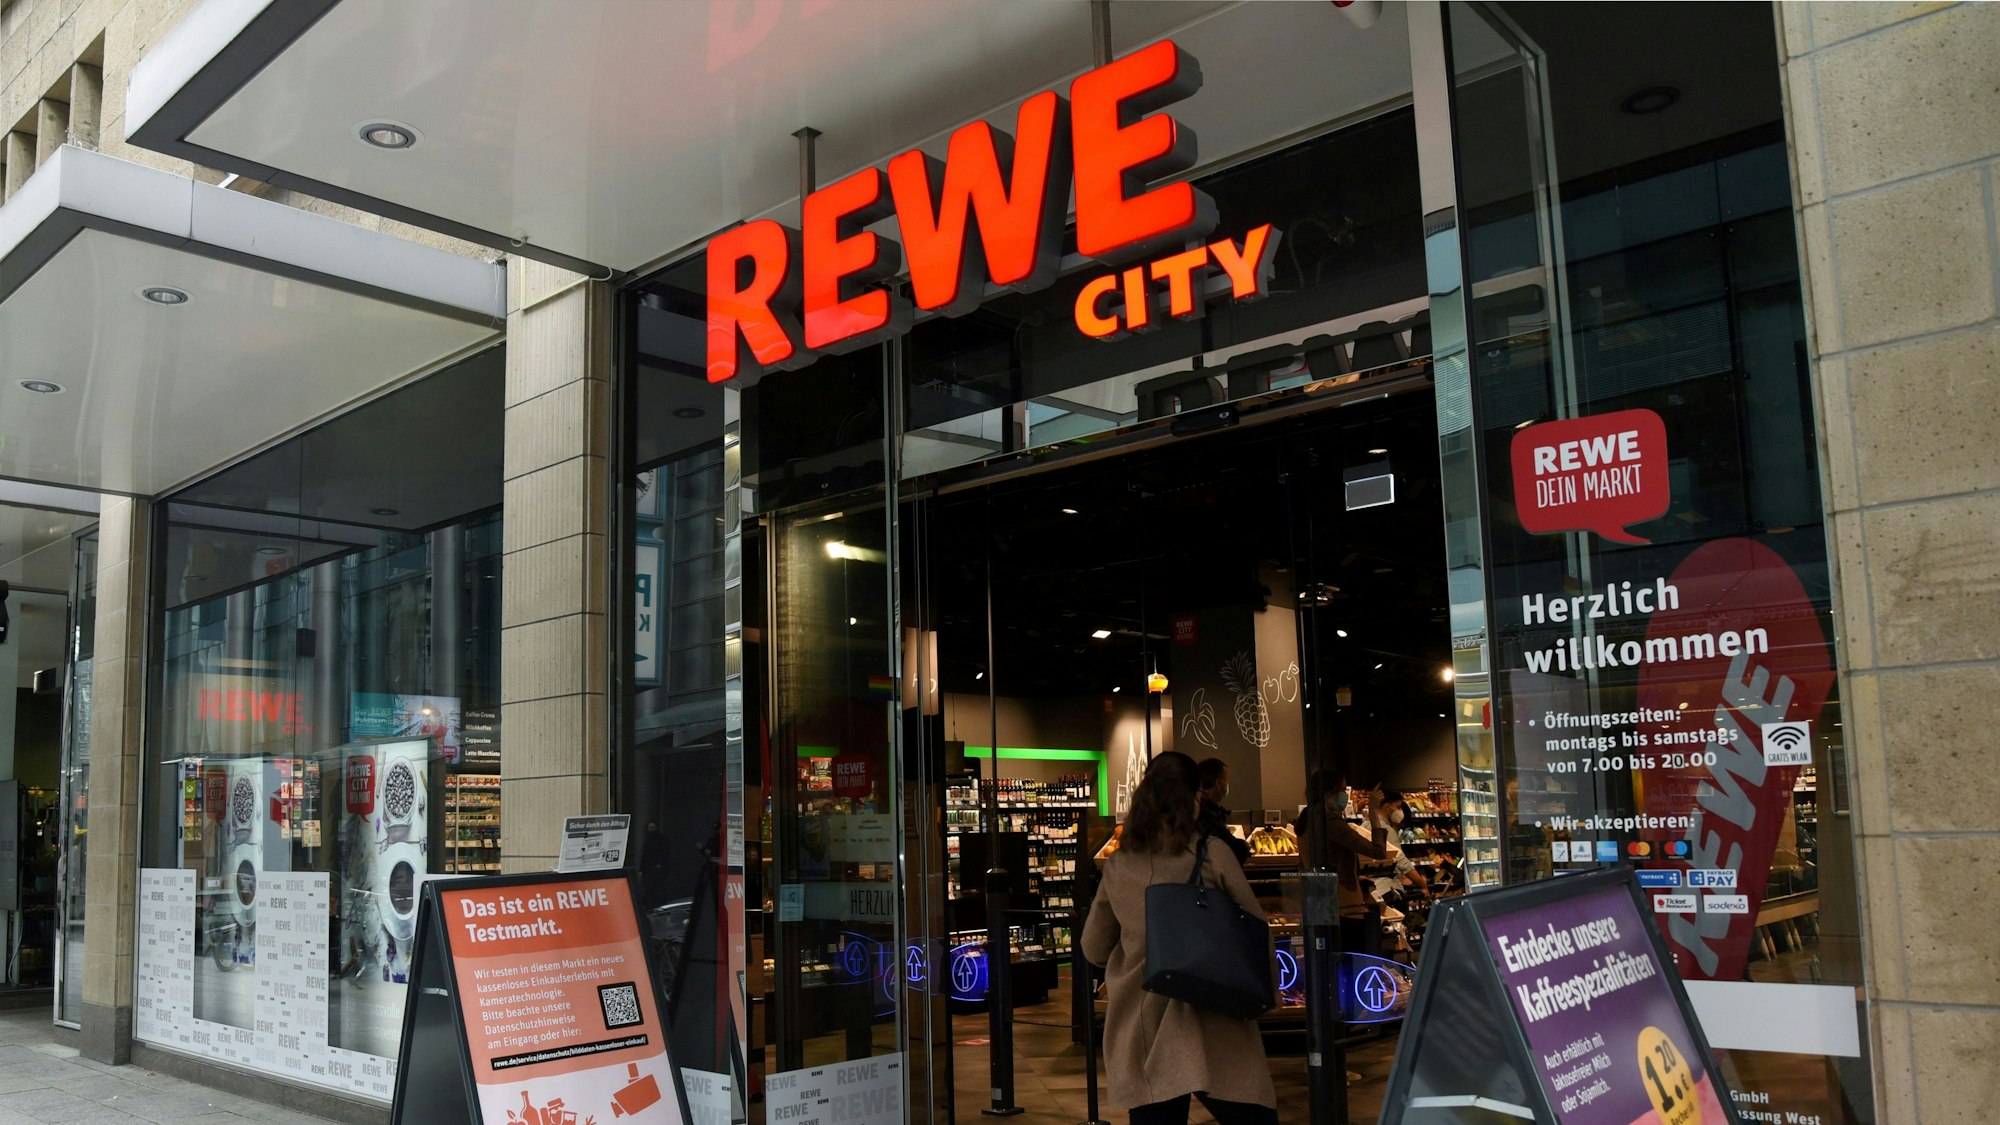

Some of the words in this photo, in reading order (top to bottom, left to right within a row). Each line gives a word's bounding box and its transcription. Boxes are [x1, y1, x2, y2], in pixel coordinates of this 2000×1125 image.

[707, 39, 1196, 384] REWE
[1075, 223, 1274, 339] CITY
[1534, 430, 1641, 476] REWE
[1536, 475, 1577, 508] DEIN
[1583, 464, 1642, 501] MARKT
[1522, 577, 1679, 625] Herzlich
[1524, 627, 1768, 674] willkommen
[198, 688, 304, 722] REWE
[1544, 709, 1681, 729] Öffnungszeiten:
[1546, 734, 1616, 751] montags
[1622, 731, 1648, 747] bis
[1654, 728, 1738, 745] samstags
[1547, 761, 1576, 773] von
[1582, 757, 1623, 773] 7.00
[1629, 754, 1656, 770] bis
[1661, 752, 1717, 769] 20.00
[1768, 753, 1789, 762] GRATIS
[1790, 752, 1808, 761] WLAN
[350, 764, 371, 776] REWE
[837, 762, 865, 775] REWE
[352, 778, 369, 790] CITY
[569, 822, 585, 830] Sicher
[586, 821, 600, 829] durch
[610, 820, 626, 828] Alltag
[1550, 816, 1579, 830] Wir
[1584, 814, 1695, 832] akzeptieren:
[1707, 876, 1734, 886] PAY
[271, 898, 287, 909] REWE
[460, 898, 496, 919] Das
[499, 896, 525, 915] ist
[528, 893, 554, 913] ein
[556, 888, 609, 910] REWE
[851, 889, 893, 916] HERZLI
[1707, 901, 1746, 910] sodexo
[465, 917, 563, 943] Testmarkt.
[282, 942, 303, 957] REWE
[1497, 923, 1576, 973] Entdecke
[1571, 916, 1620, 951] unsere
[474, 968, 490, 979] Wir
[492, 966, 518, 977] testen
[520, 964, 529, 974] in
[531, 961, 560, 973] diesem
[562, 958, 585, 969] Markt
[587, 957, 600, 967] ein
[601, 954, 624, 965] neues
[306, 976, 325, 990] REWE
[476, 980, 529, 993] kassenloses
[531, 971, 599, 987] Einkaufserlebnis
[601, 968, 615, 978] mit
[1516, 951, 1656, 1023] Kaffeespezialitäten
[274, 982, 296, 999] REWE
[479, 989, 565, 1008] Kameratechnologie.
[156, 1008, 172, 1022] REWE
[482, 1009, 504, 1021] Bitte
[506, 1006, 541, 1018] beachte
[542, 1002, 571, 1013] unsere
[256, 1020, 273, 1033] REWE
[485, 1016, 576, 1035] Datenschutzhinweise
[193, 1030, 210, 1045] REWE
[235, 1029, 254, 1045] REWE
[279, 1034, 300, 1050] REWE
[488, 1040, 502, 1049] am
[504, 1036, 539, 1047] Eingang
[541, 1031, 560, 1042] oder
[562, 1029, 582, 1039] hier:
[1543, 1050, 1563, 1070] Auch
[1562, 1036, 1593, 1063] erhältlich
[1593, 1032, 1605, 1047] mit
[311, 1065, 325, 1076] REWE
[329, 1060, 352, 1079] REWE
[362, 1063, 381, 1077] REWE
[836, 1063, 878, 1085] REWE
[1551, 1062, 1594, 1091] laktosefreier
[1592, 1053, 1612, 1072] Milch
[800, 1089, 821, 1099] REWE
[830, 1084, 898, 1123] REWE
[1561, 1093, 1579, 1113] oder
[1576, 1078, 1611, 1105] Sojamilch.
[1730, 1090, 1769, 1104] GmbH
[775, 1103, 808, 1120] REWE
[1785, 1111, 1820, 1125] West
